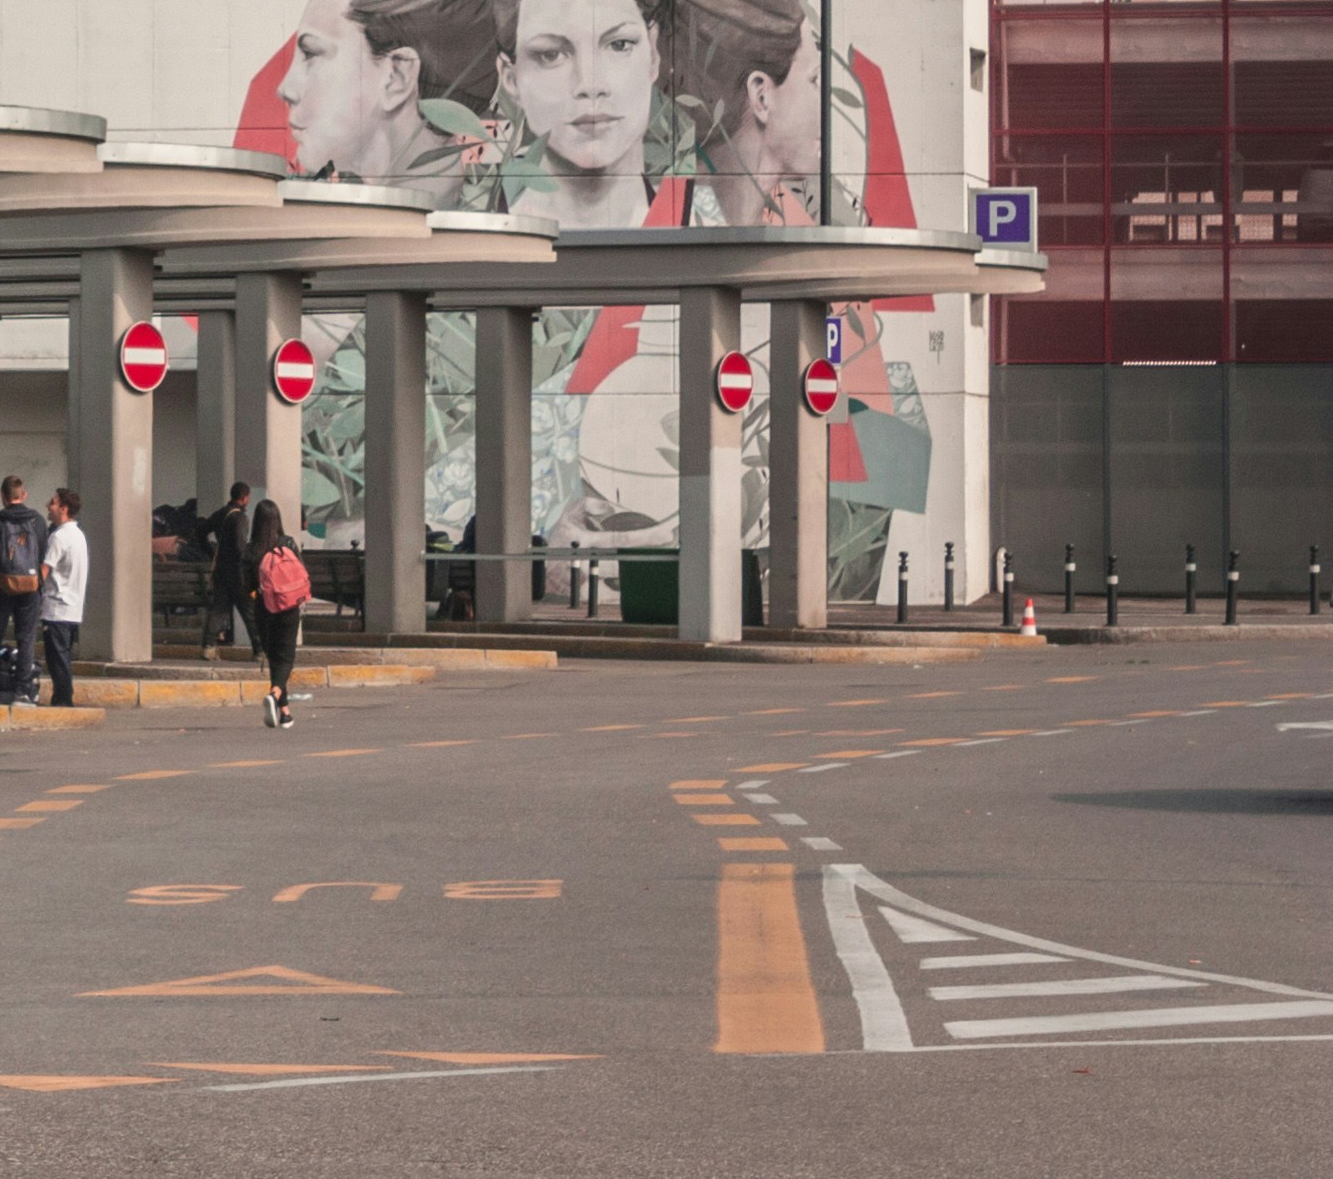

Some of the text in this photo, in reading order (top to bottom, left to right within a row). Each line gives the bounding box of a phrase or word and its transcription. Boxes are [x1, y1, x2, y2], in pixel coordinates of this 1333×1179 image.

[989, 200, 1017, 237] P
[827, 323, 839, 360] P
[125, 878, 564, 906] BUS
